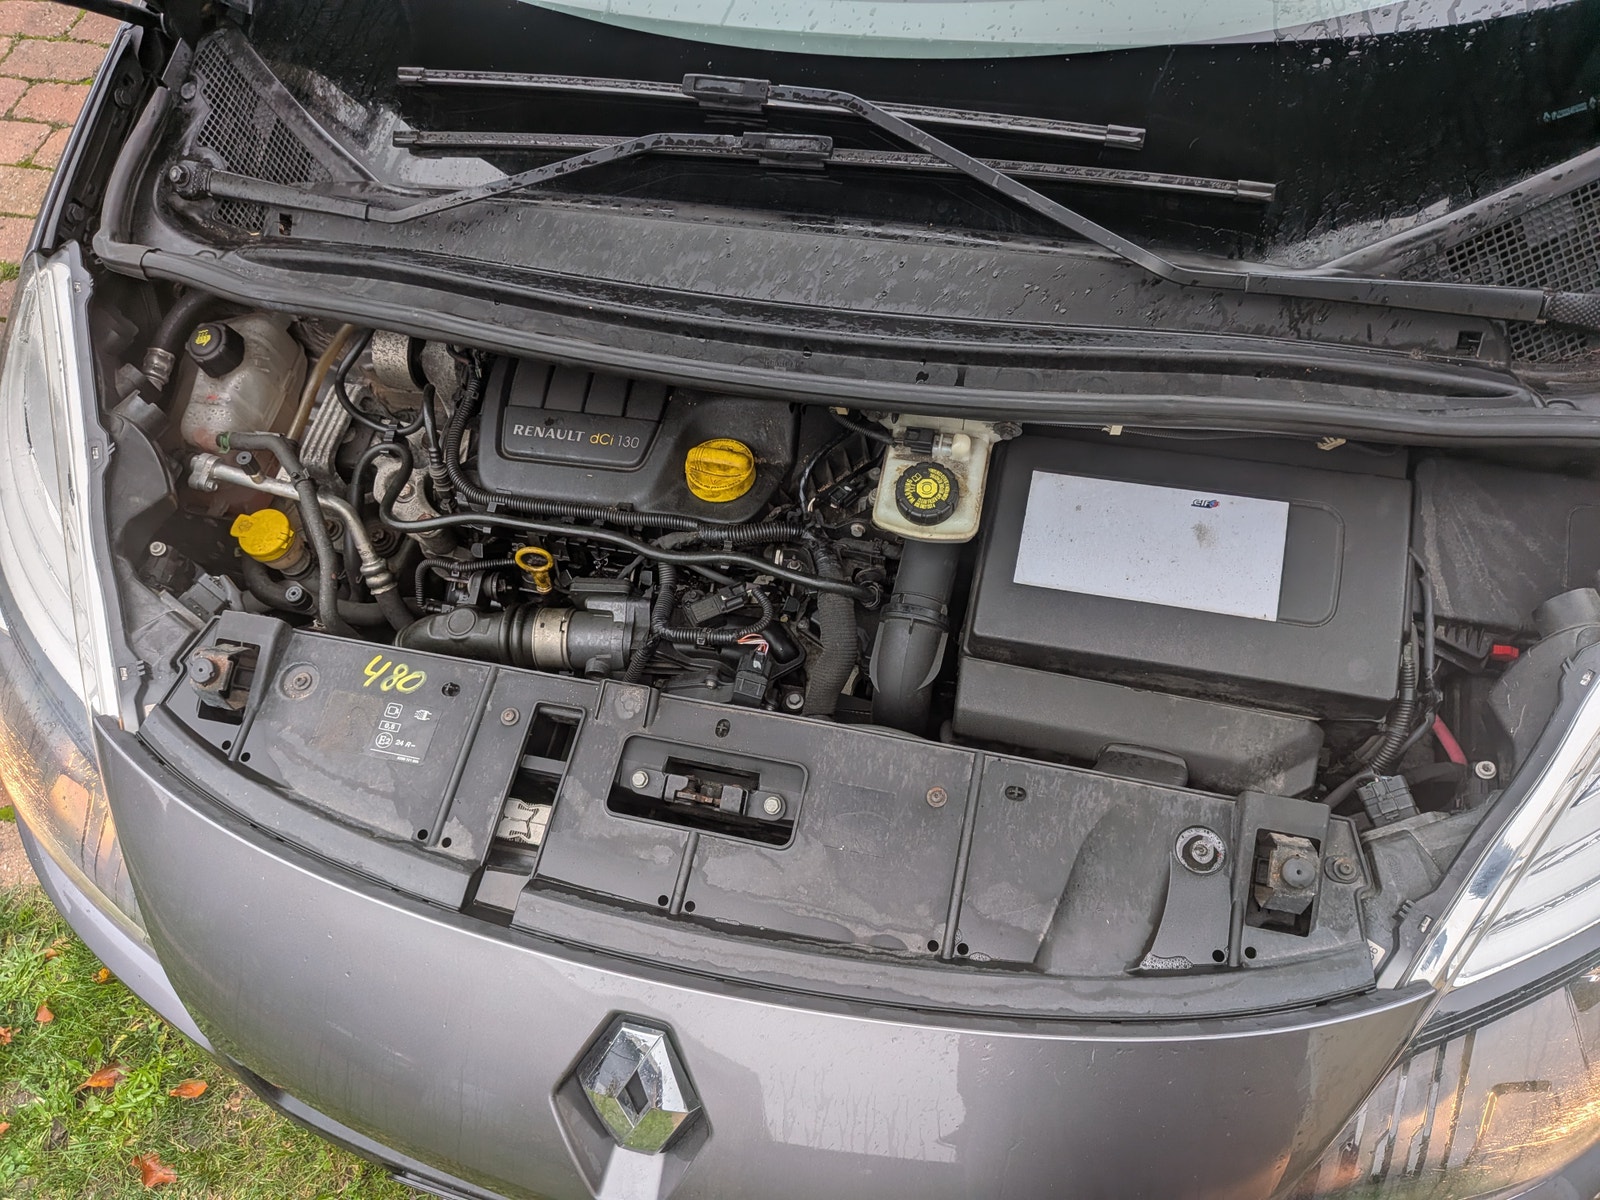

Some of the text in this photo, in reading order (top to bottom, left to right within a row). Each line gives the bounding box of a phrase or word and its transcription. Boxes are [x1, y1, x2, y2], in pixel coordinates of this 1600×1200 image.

[513, 424, 640, 449] RENAULT dCi 130
[363, 654, 427, 695] 480
